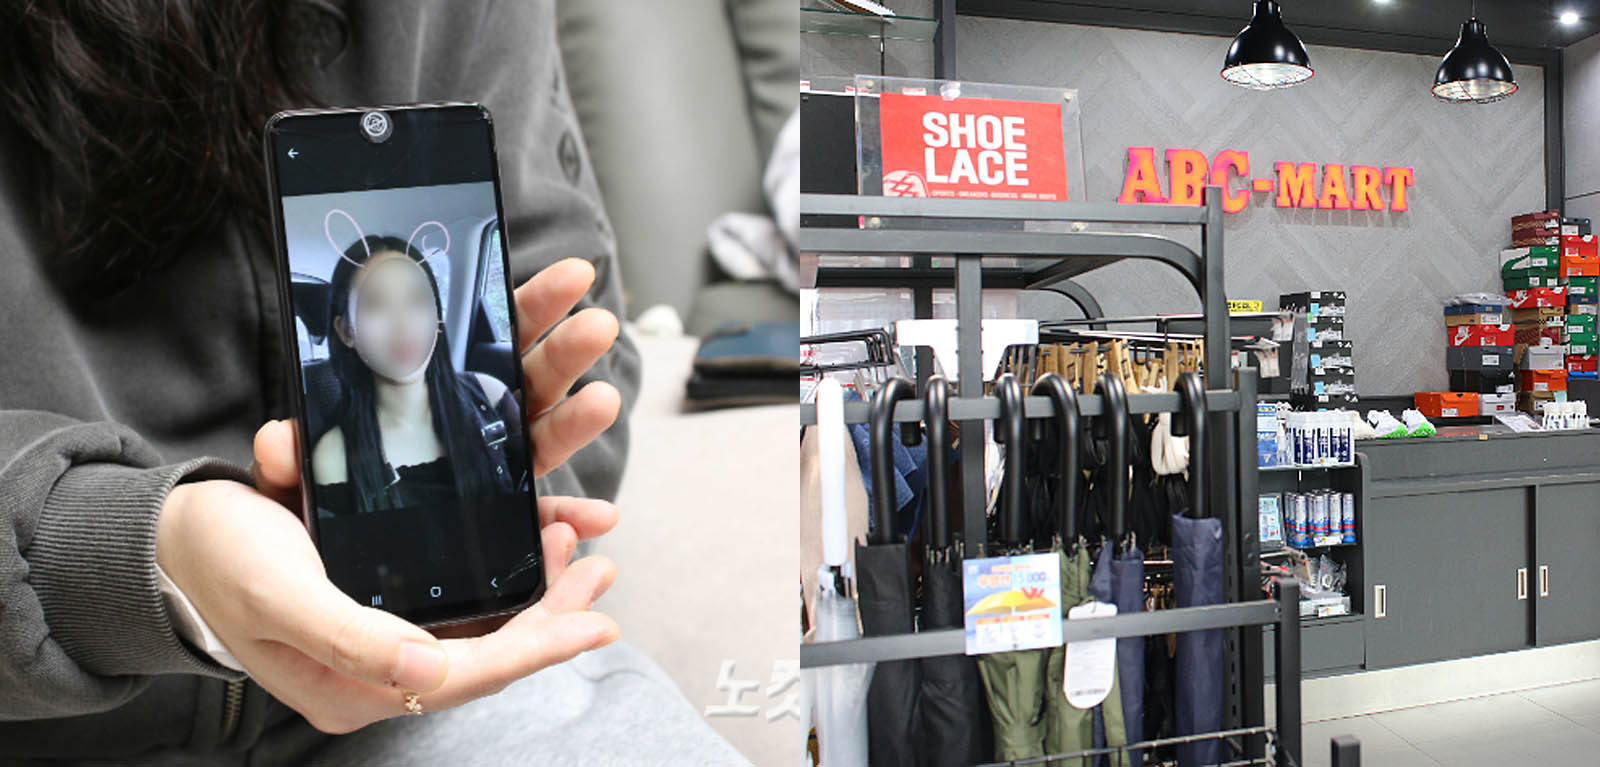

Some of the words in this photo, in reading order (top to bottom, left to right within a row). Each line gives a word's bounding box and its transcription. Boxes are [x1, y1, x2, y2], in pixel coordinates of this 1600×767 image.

[922, 111, 1026, 151] SHOE
[924, 147, 1029, 186] LACE
[1117, 146, 1415, 213] ABC-MART
